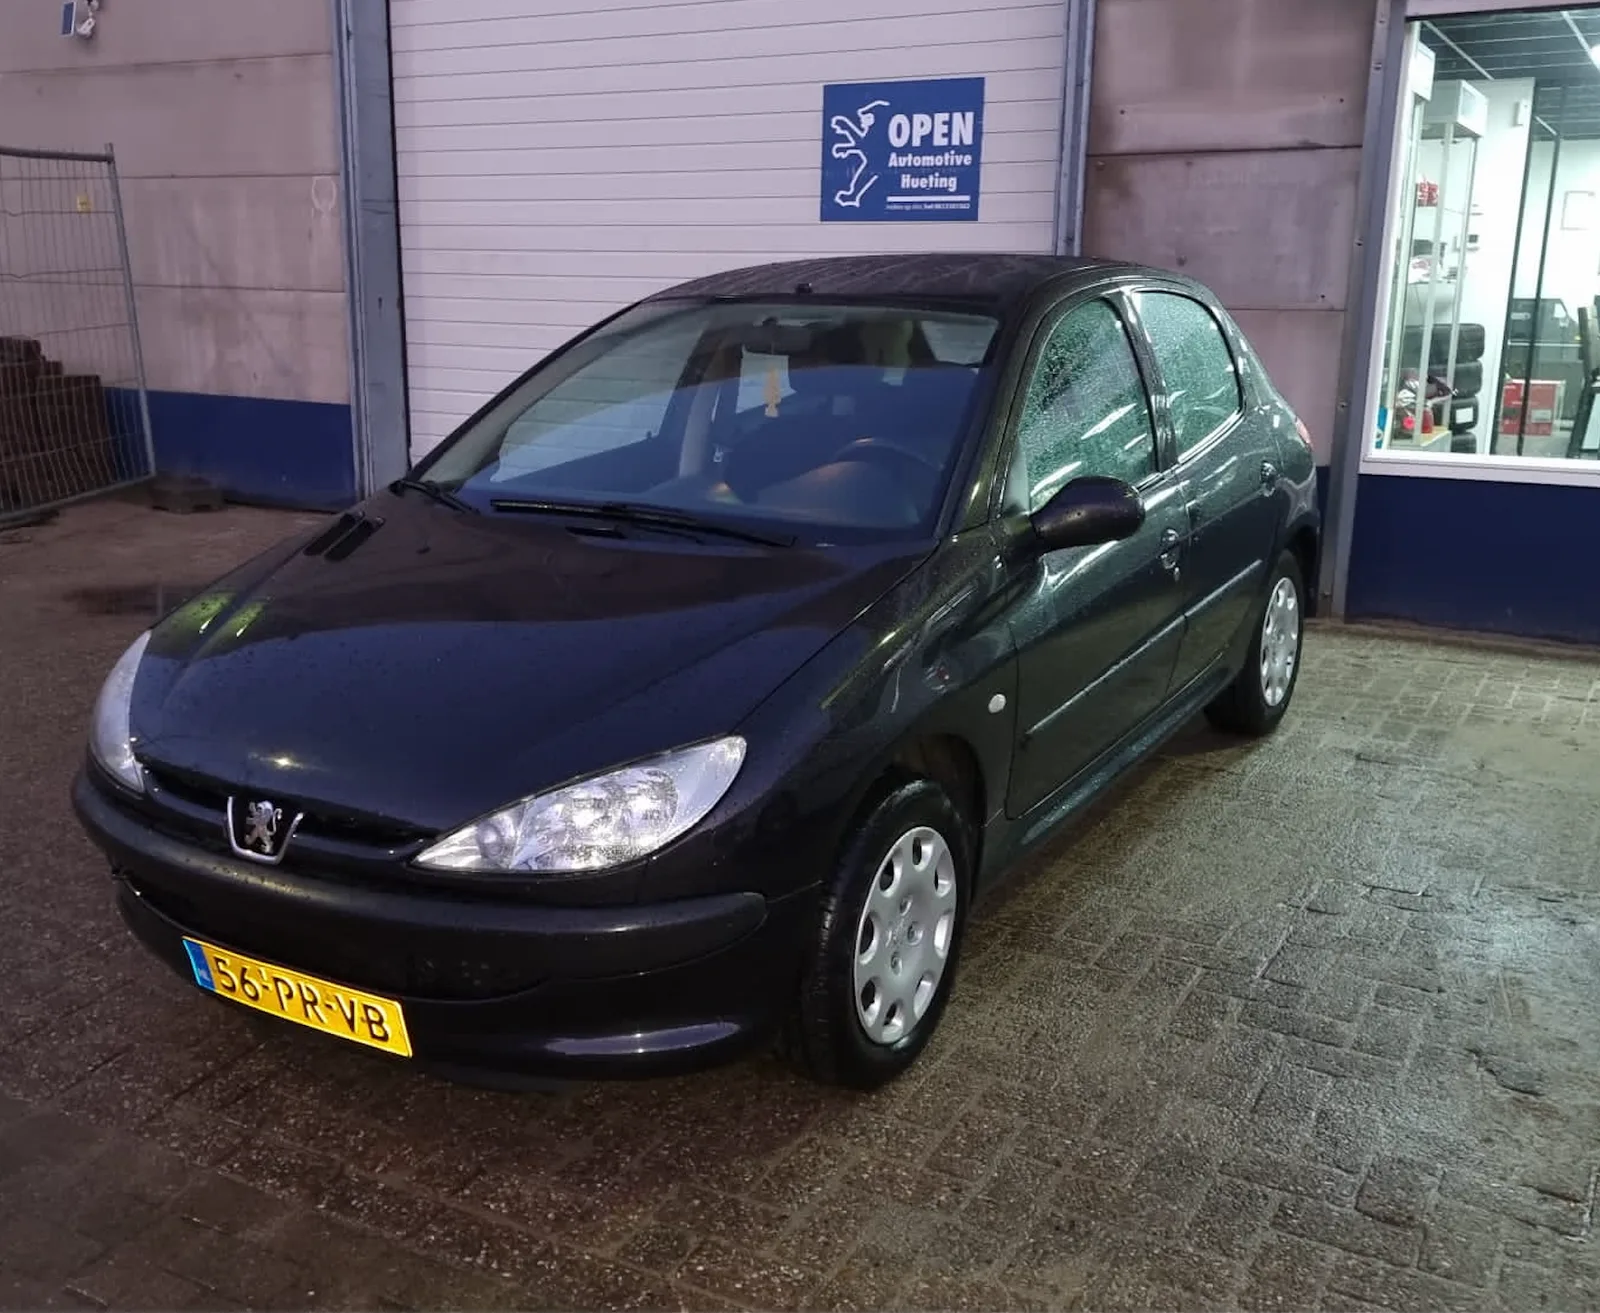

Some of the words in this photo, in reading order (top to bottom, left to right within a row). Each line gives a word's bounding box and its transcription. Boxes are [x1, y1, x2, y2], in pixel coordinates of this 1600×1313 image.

[888, 112, 974, 148] OPEN
[888, 150, 972, 167] Automotive
[900, 173, 957, 192] Hueting
